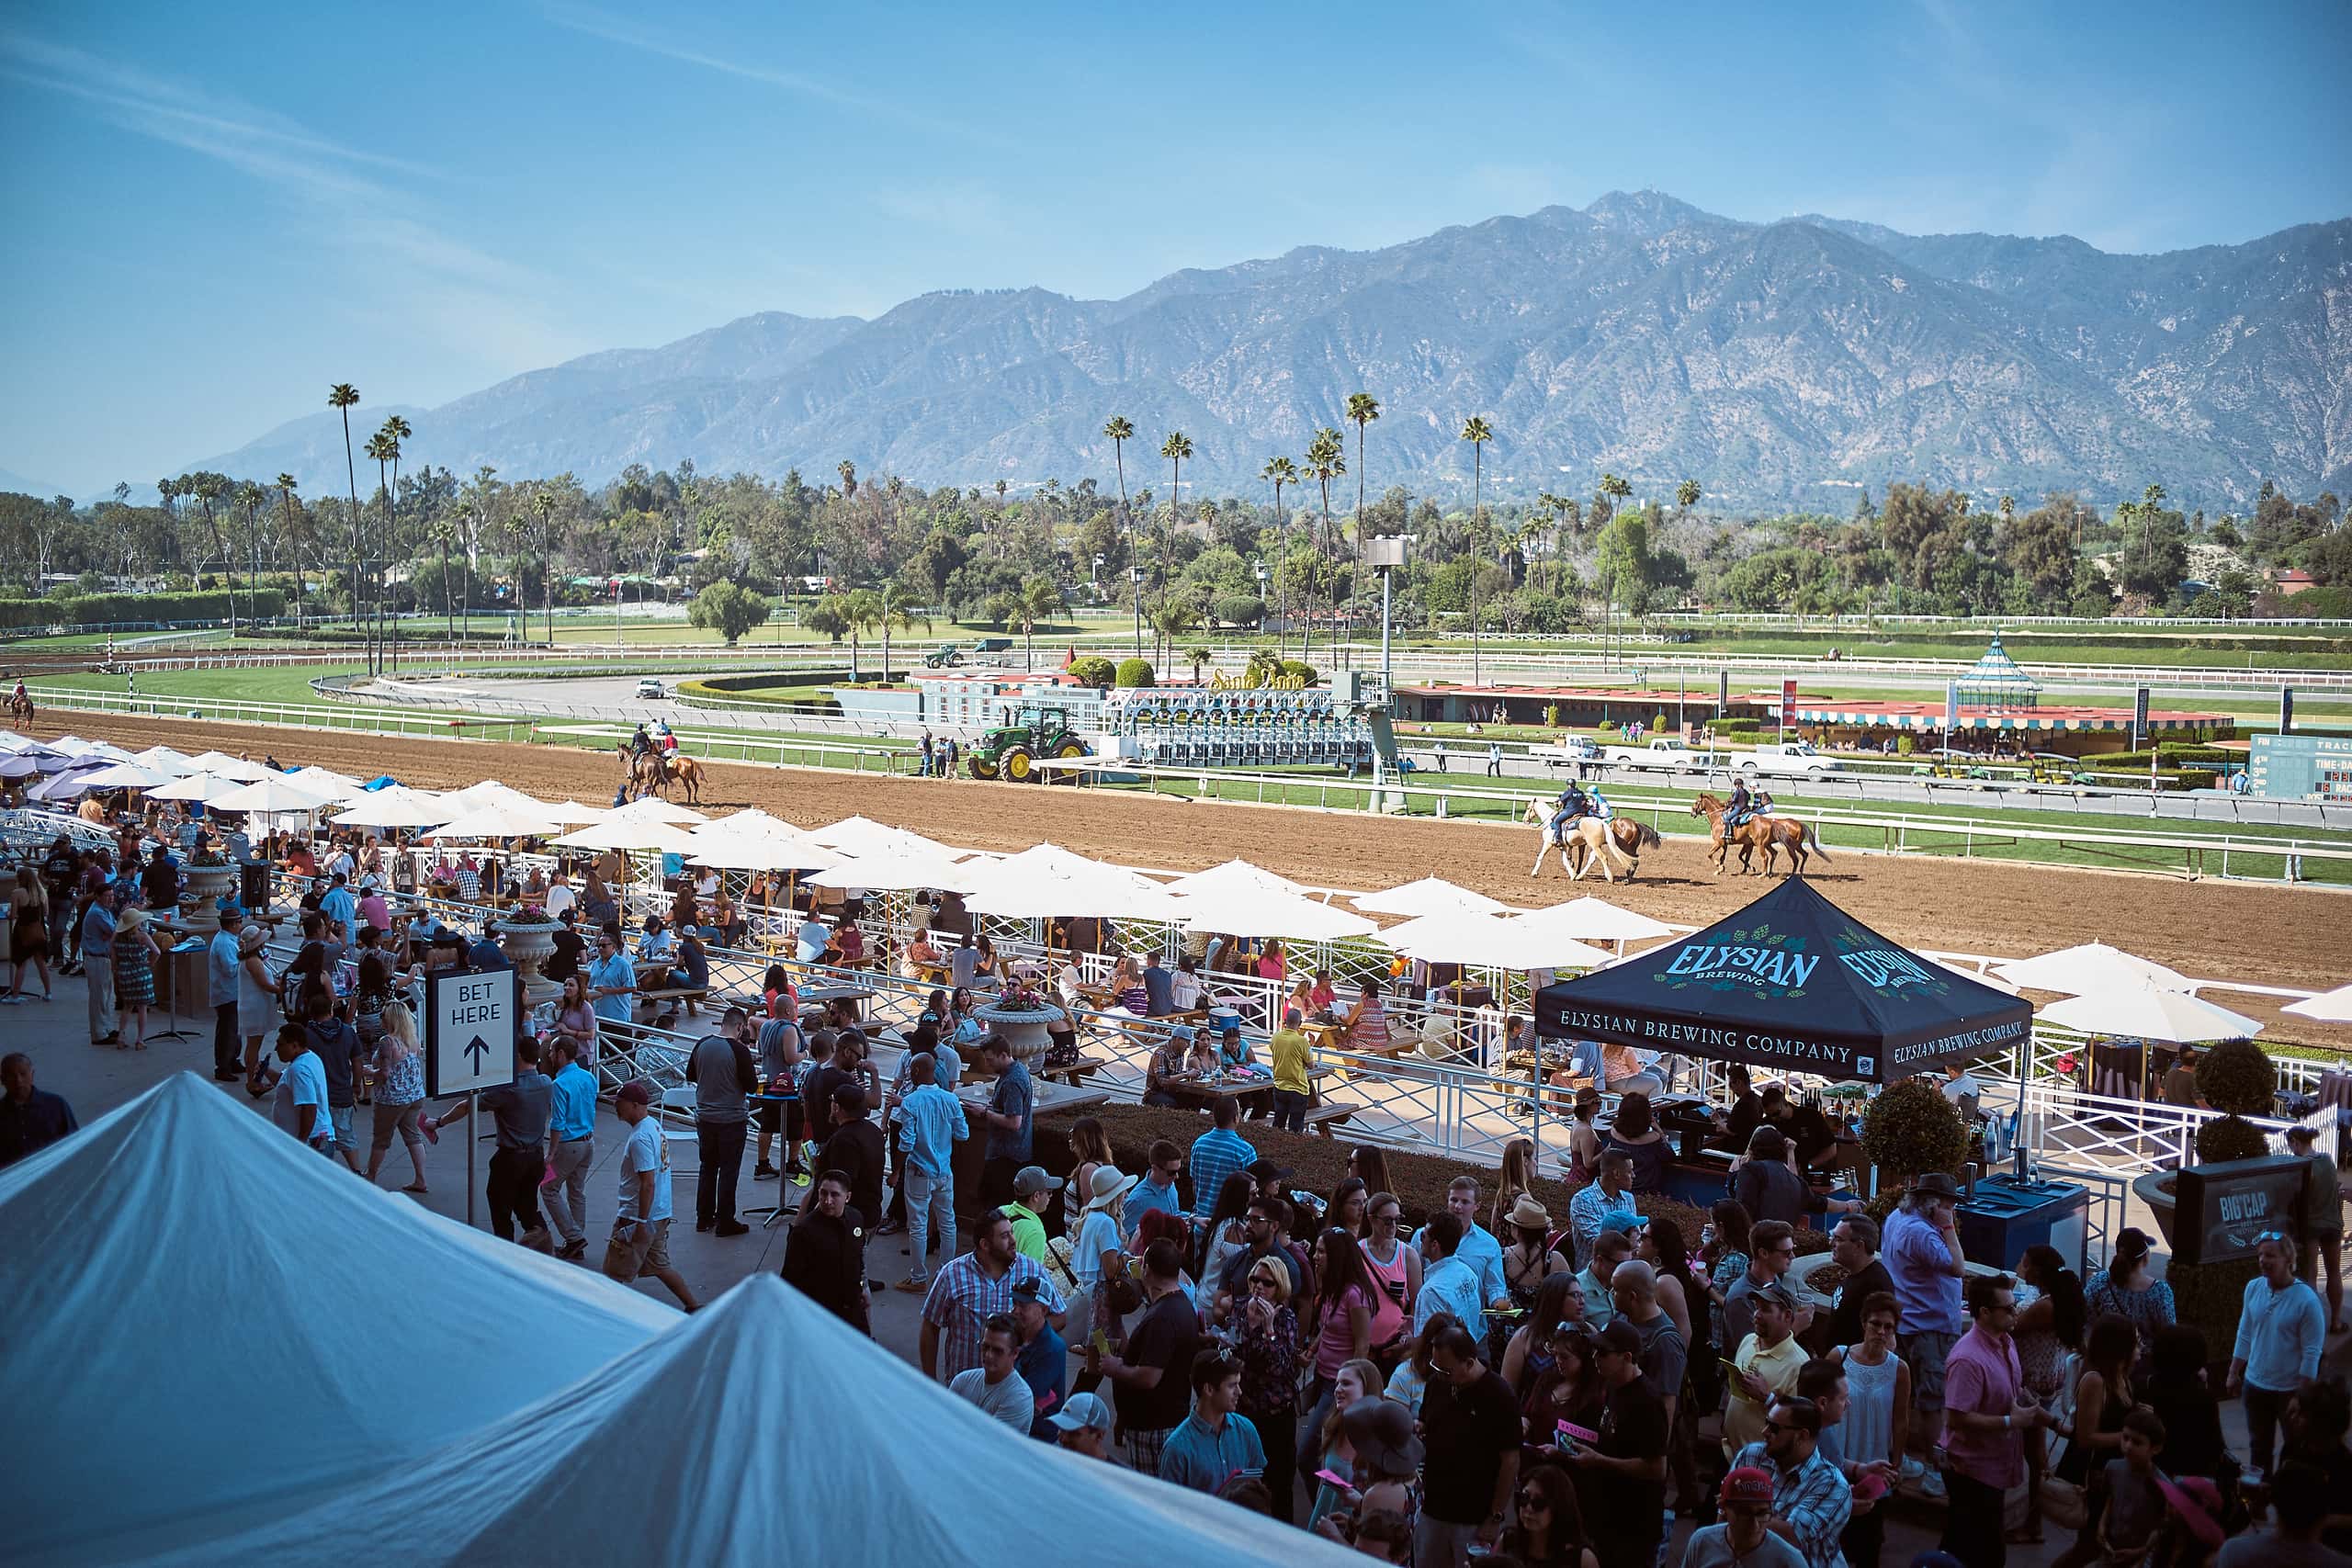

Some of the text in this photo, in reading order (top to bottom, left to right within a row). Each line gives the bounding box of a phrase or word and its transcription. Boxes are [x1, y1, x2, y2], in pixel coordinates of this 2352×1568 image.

[1209, 667, 1306, 694] Santa Anita
[2257, 737, 2270, 746] FIN
[2316, 741, 2352, 750] TRAC
[1666, 944, 1821, 988] ELYSIAN
[1695, 972, 1766, 987] BREWING
[1838, 948, 1936, 987] ELYSIAN
[458, 982, 494, 1003] BET
[452, 1003, 501, 1026] HERE
[1561, 1010, 1851, 1064] ELYSIAN BREWING COMPANY
[1894, 1021, 2022, 1065] ELYSIAN BREWING COMPANY
[2219, 1195, 2242, 1222] BIG
